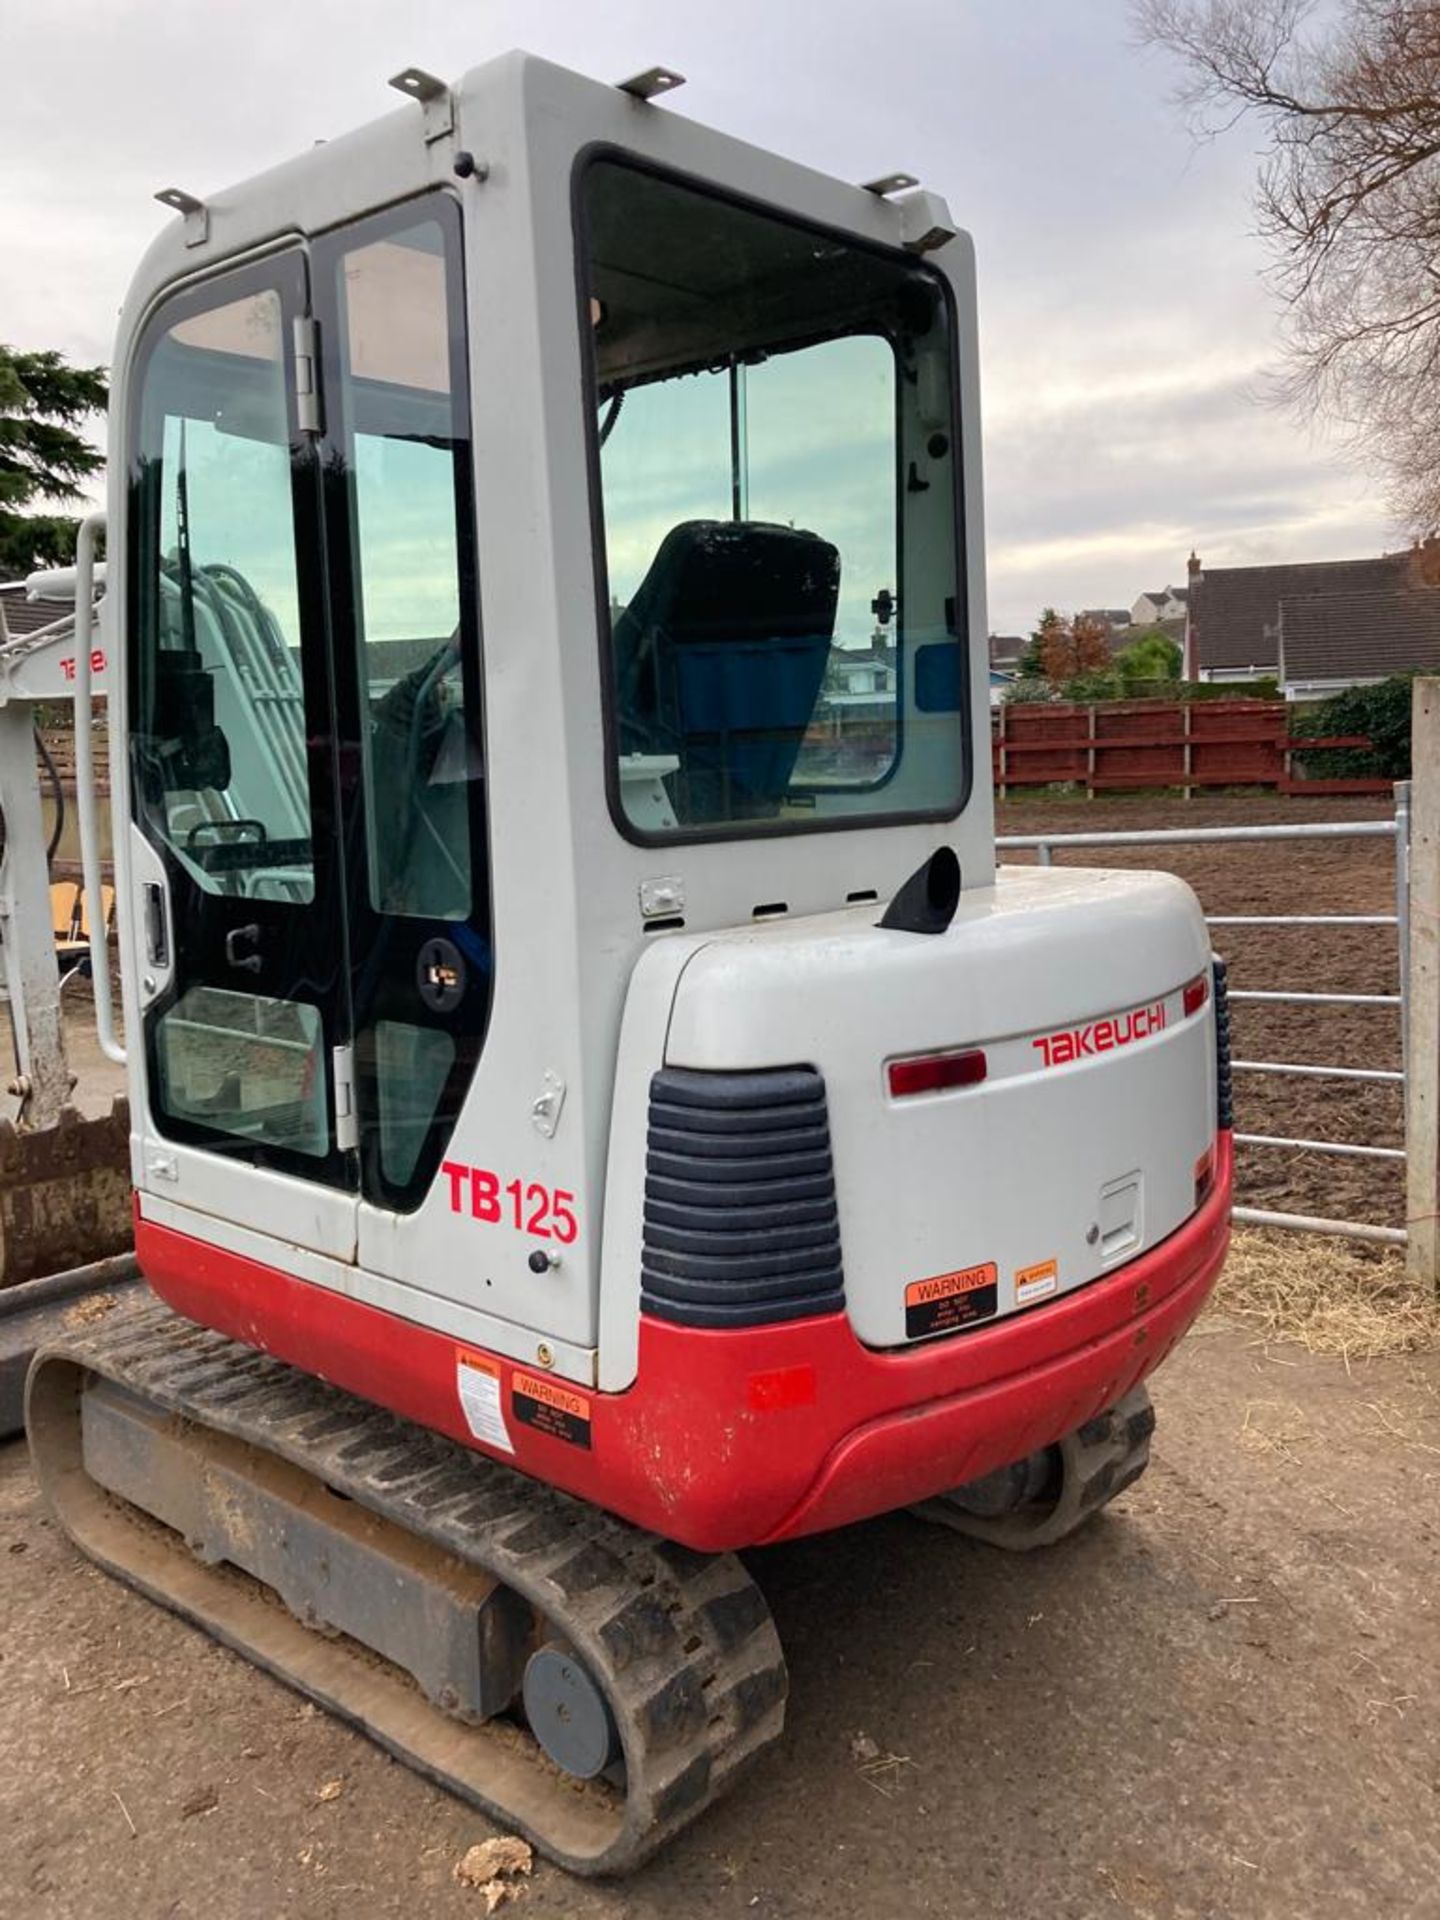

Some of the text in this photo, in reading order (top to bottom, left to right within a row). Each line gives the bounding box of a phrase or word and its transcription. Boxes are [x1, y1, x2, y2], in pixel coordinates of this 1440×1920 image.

[442, 1160, 578, 1244] TB125
[918, 1269, 986, 1300] WARNING
[520, 1377, 580, 1413] WARNING
